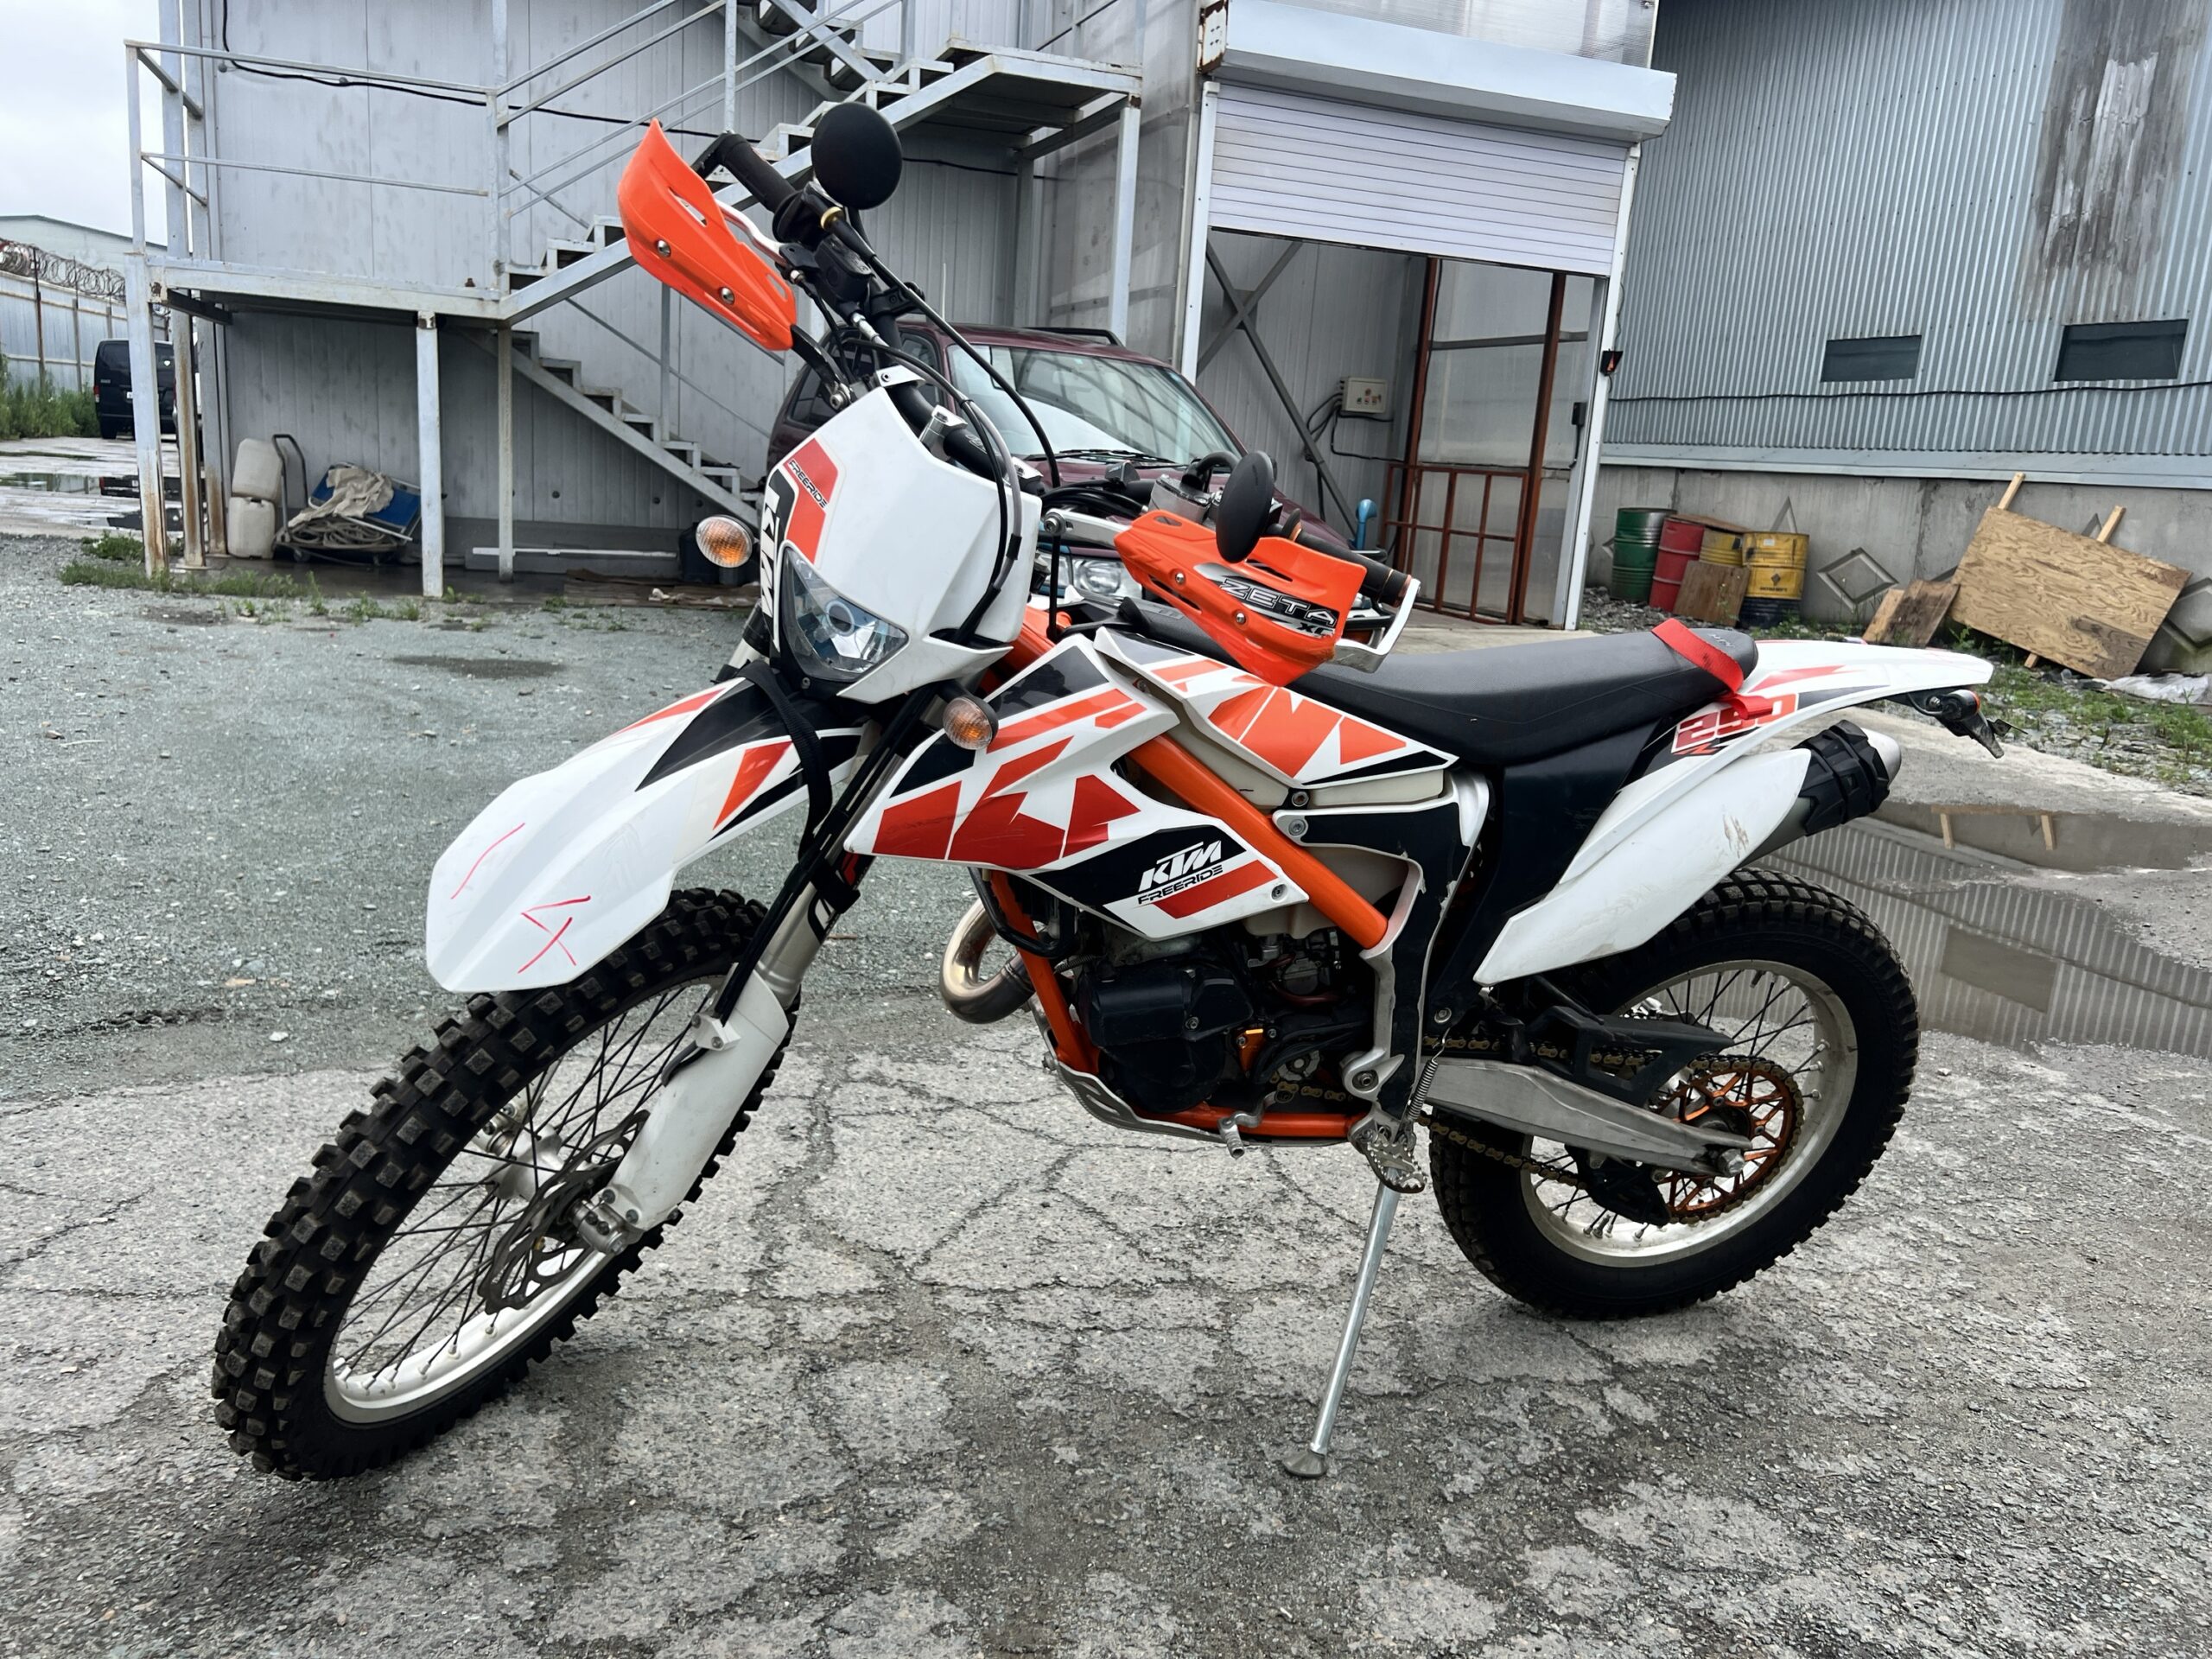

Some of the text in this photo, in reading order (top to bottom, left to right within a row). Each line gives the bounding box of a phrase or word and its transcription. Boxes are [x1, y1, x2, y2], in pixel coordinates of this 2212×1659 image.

[787, 459, 828, 509] FREERIDE
[760, 485, 781, 618] KTM
[1219, 577, 1337, 627] ZETA
[1137, 839, 1222, 893] KTM
[1137, 864, 1224, 905] FREERIDE
